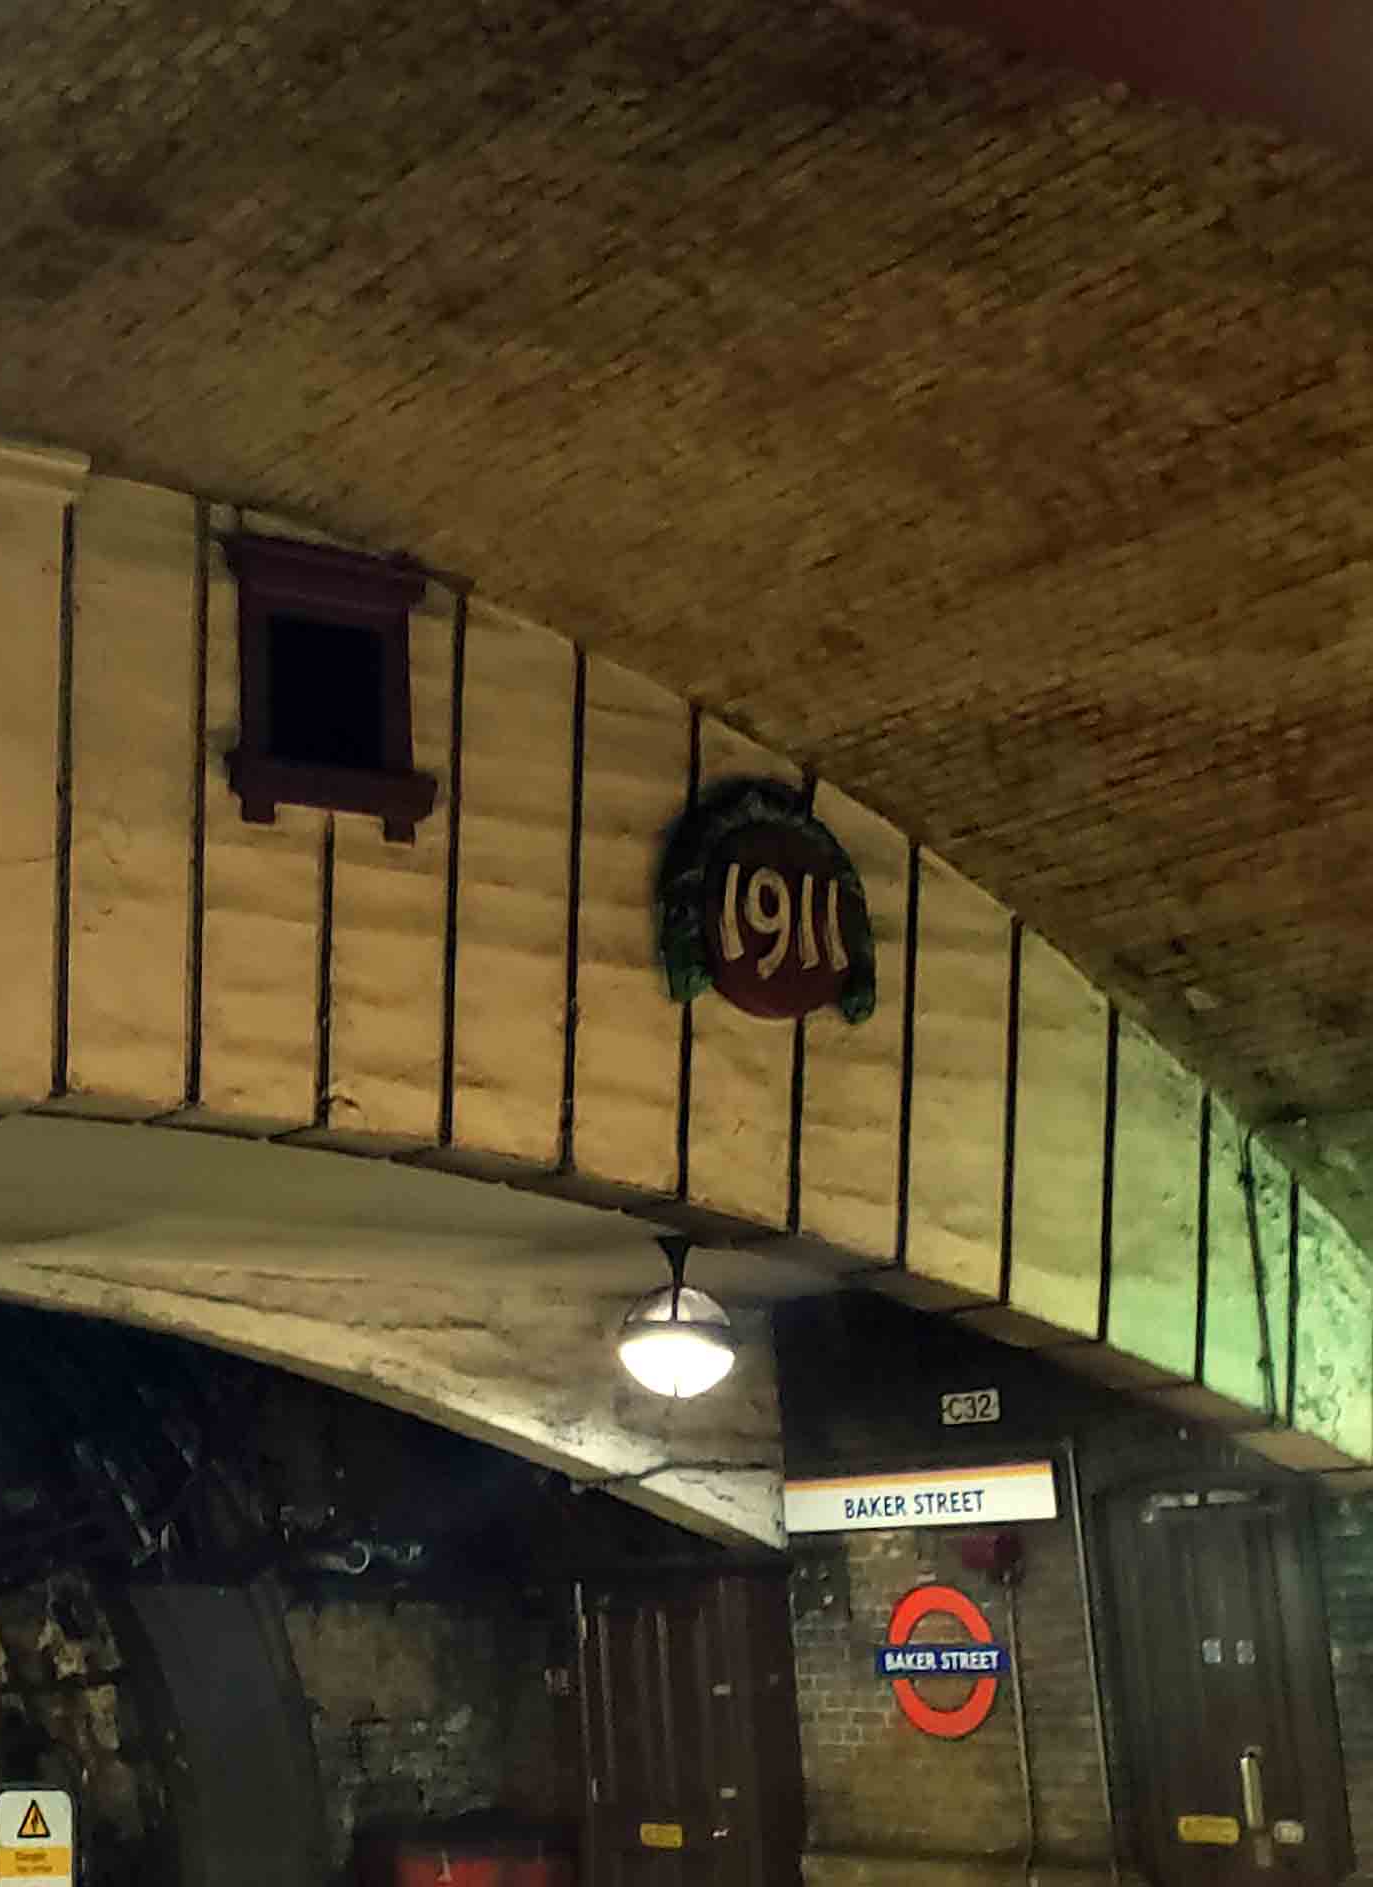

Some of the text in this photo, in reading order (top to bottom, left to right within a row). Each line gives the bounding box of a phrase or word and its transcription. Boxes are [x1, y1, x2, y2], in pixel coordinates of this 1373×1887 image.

[721, 863, 849, 979] 1911
[947, 1394, 993, 1421] C32
[844, 1489, 985, 1519] BAKER STREET
[884, 1650, 999, 1672] BAKER STREET
